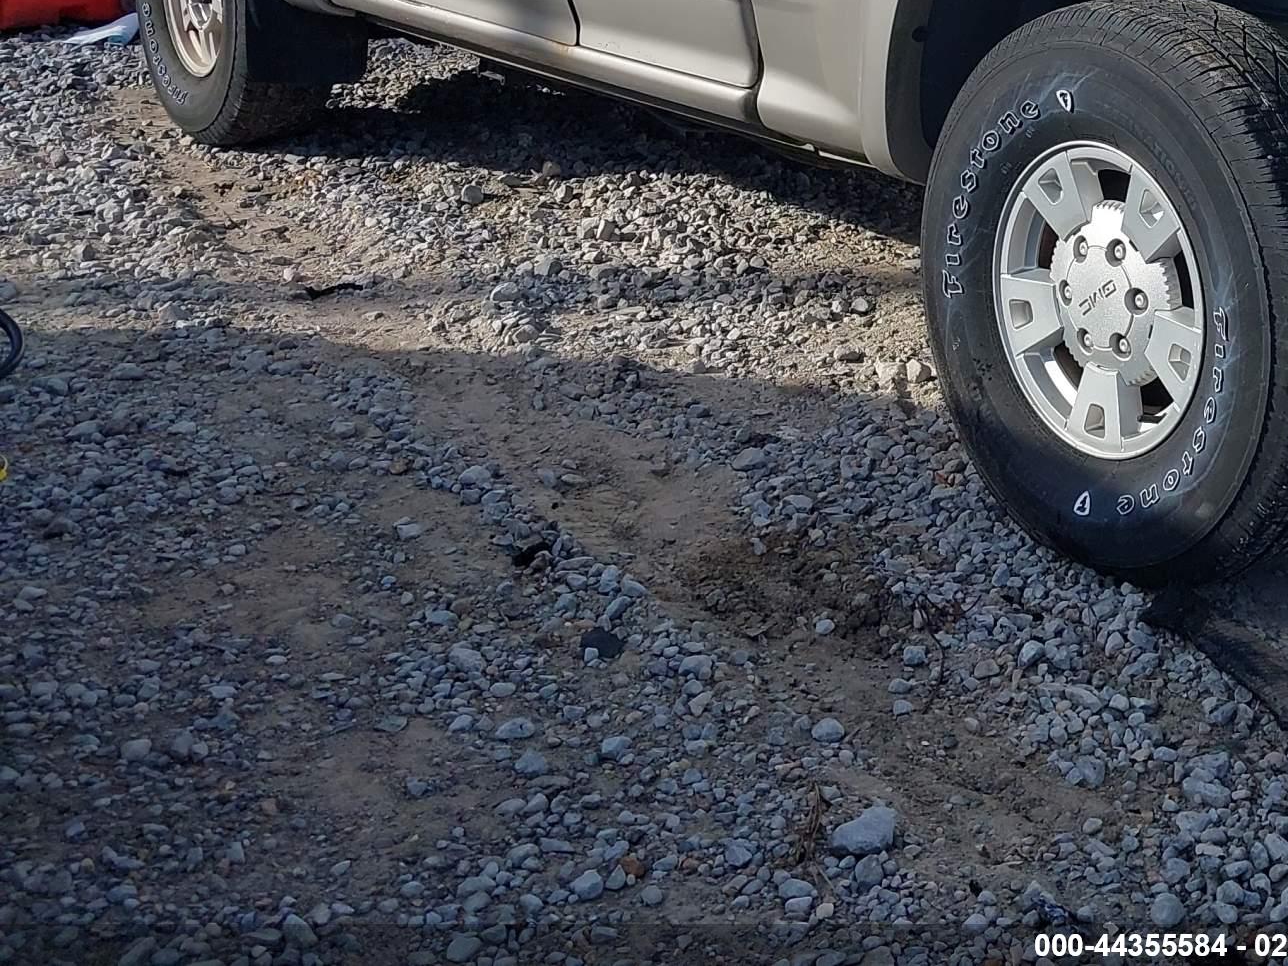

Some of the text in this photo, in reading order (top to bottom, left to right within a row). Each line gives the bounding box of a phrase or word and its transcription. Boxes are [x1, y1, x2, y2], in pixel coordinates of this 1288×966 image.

[942, 100, 1041, 299] Firestone
[1078, 279, 1117, 316] GMC
[1115, 306, 1230, 516] Firestone
